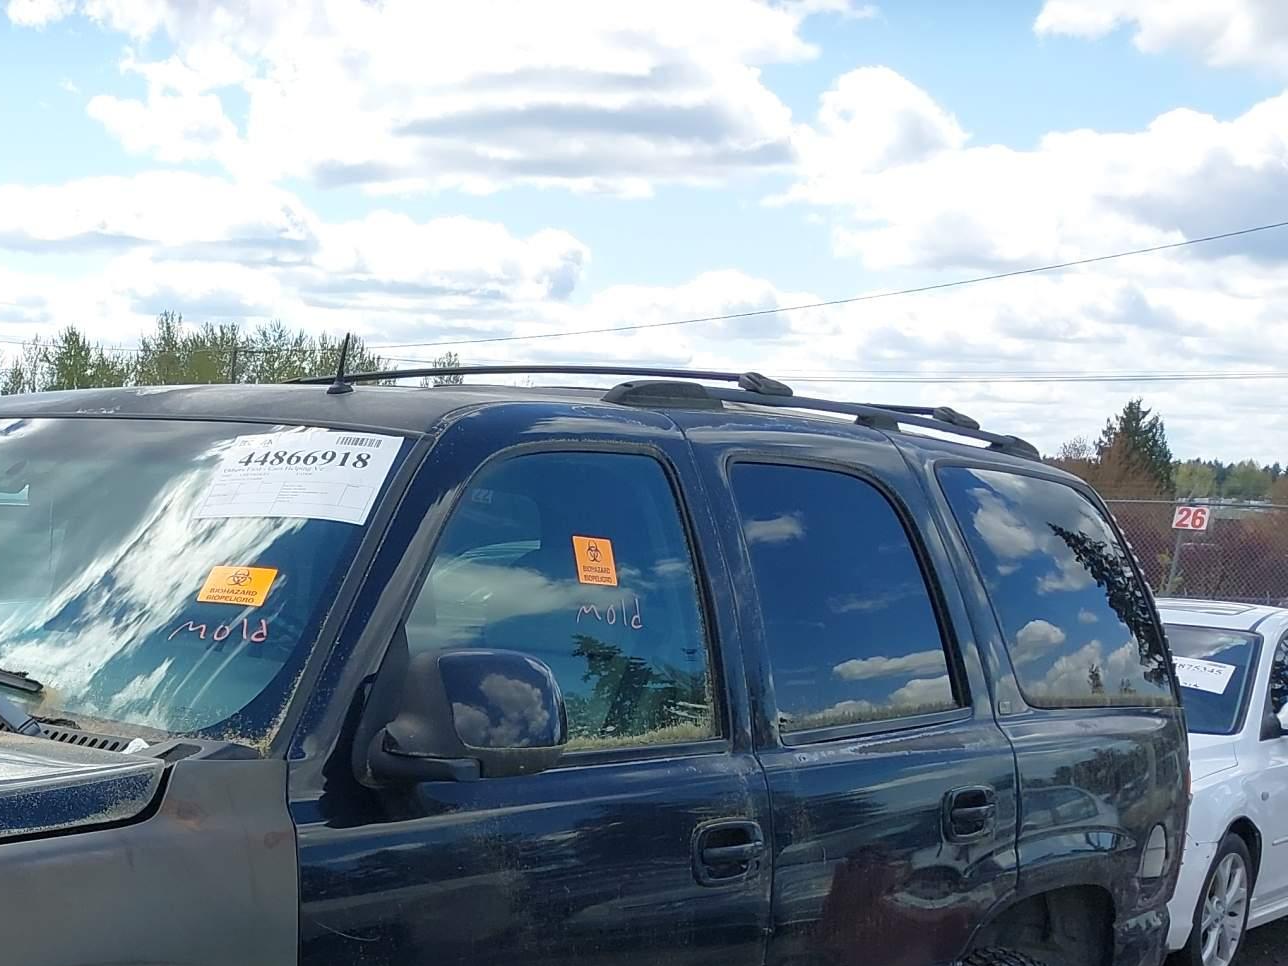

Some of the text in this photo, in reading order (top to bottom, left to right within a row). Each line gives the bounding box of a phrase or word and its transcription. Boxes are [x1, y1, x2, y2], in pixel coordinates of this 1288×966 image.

[238, 450, 372, 469] 44866918
[1175, 507, 1207, 528] 26
[206, 594, 255, 603] BIOPELIGRO
[209, 587, 258, 597] BIOHAZARD
